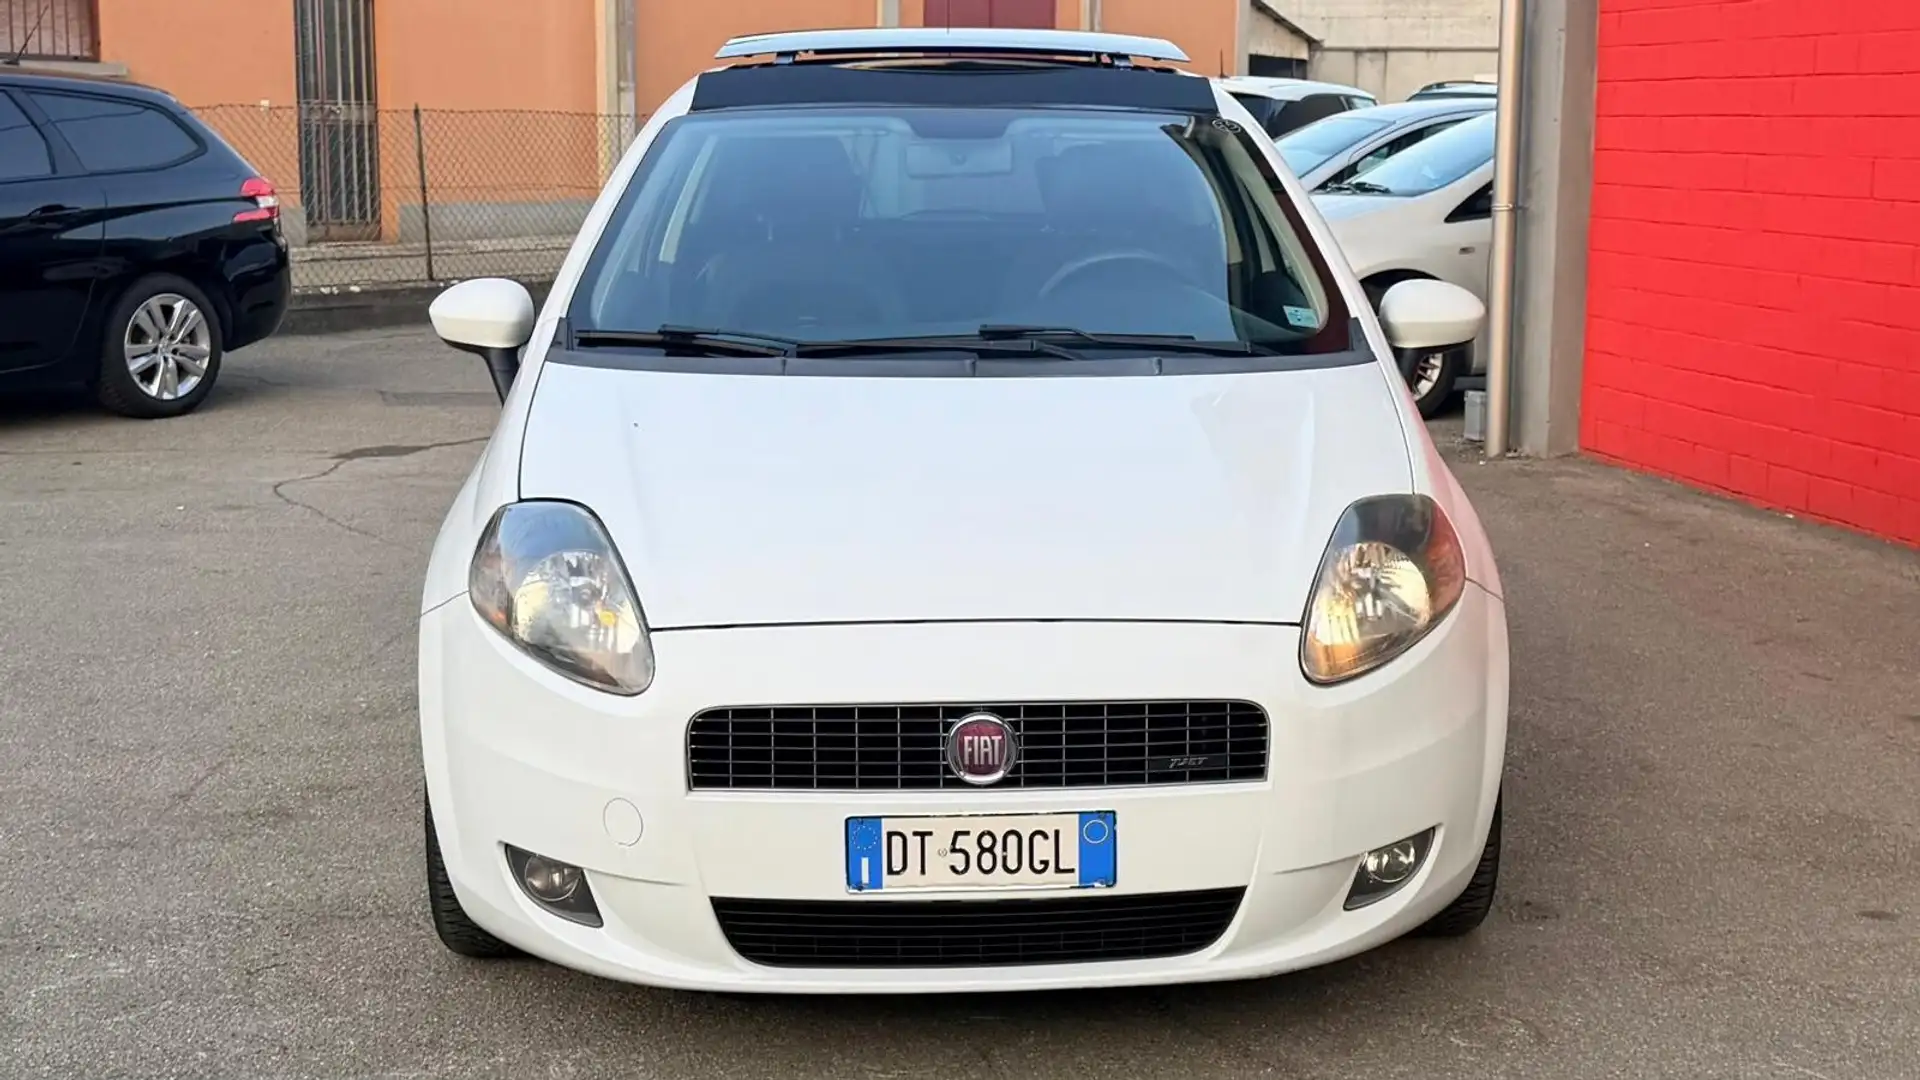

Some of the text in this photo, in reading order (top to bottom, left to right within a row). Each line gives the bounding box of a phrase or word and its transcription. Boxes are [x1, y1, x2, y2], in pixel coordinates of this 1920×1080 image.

[964, 735, 1002, 766] FIAT
[886, 829, 1076, 876] DT 580GL
